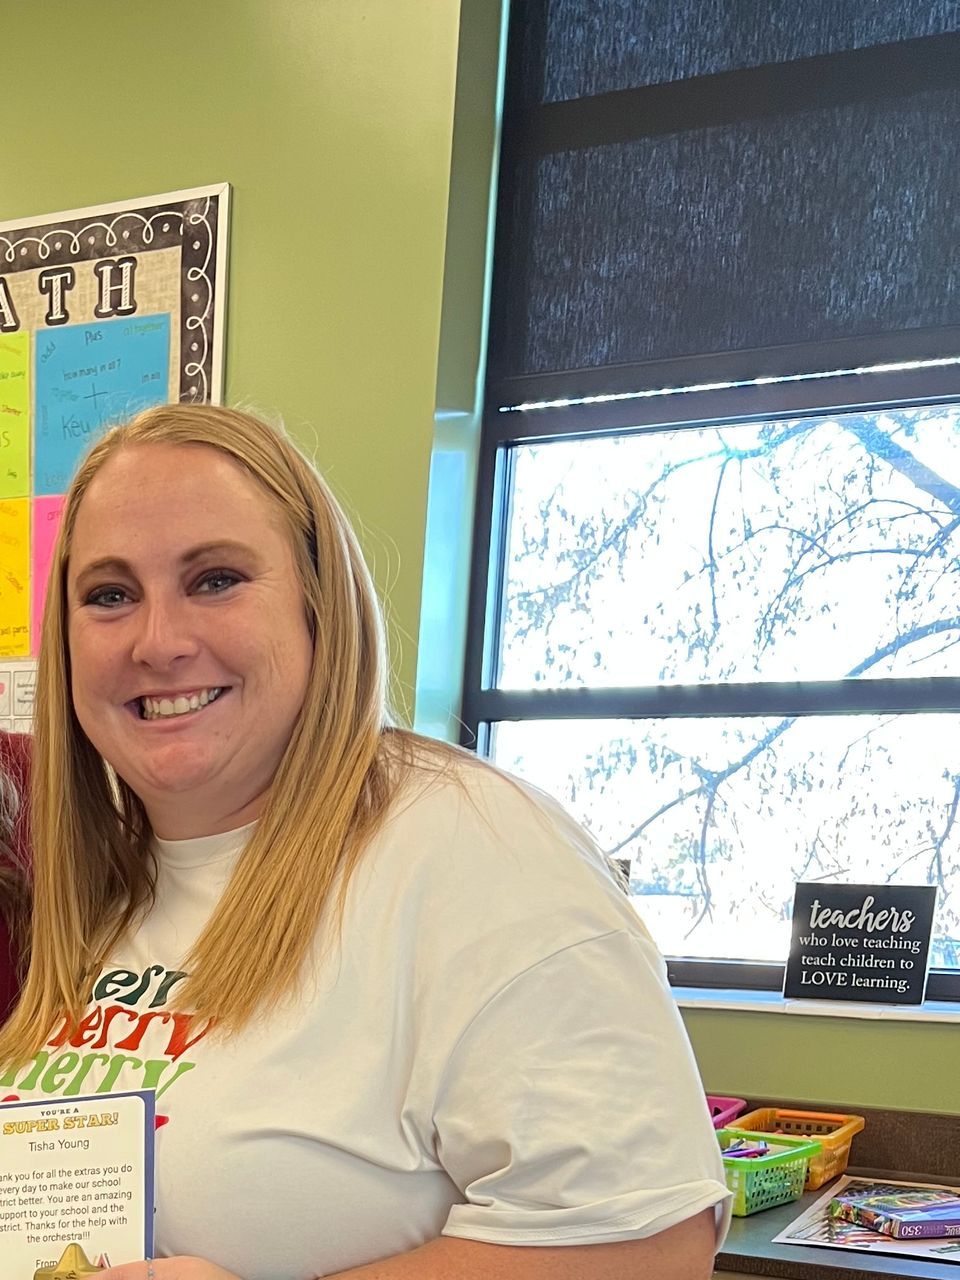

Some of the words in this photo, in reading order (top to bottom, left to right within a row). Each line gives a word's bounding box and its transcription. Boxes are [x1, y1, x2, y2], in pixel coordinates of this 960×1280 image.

[809, 896, 915, 933] teachers
[799, 933, 827, 947] who
[832, 933, 859, 948] love
[863, 936, 921, 953] teaching
[801, 953, 835, 966] teach
[840, 954, 895, 969] children
[900, 958, 914, 969] to
[92, 964, 189, 1008] err
[801, 971, 847, 986] LOVE
[851, 973, 910, 993] learning.
[40, 1108, 71, 1116] YOU'RE
[3, 1119, 60, 1135] SUPER
[63, 1112, 118, 1128] STAR!
[29, 1142, 55, 1152] Tisha
[58, 1139, 90, 1150] Young
[15, 1173, 30, 1182] you
[32, 1171, 44, 1179] for
[46, 1169, 56, 1178] all
[59, 1169, 72, 1177] the
[74, 1166, 100, 1176] extras
[103, 1166, 118, 1175] you
[121, 1164, 133, 1173] do
[22, 1184, 37, 1193] day
[39, 1183, 47, 1191] to
[50, 1181, 73, 1191] make
[76, 1180, 90, 1188] our
[92, 1178, 121, 1187] school
[18, 1196, 45, 1205] better.
[47, 1195, 63, 1203] You
[66, 1194, 79, 1202] are
[94, 1191, 132, 1203] amazing
[29, 1210, 38, 1218] to
[40, 1208, 58, 1218] your
[61, 1206, 89, 1215] school
[92, 1205, 108, 1214] and
[110, 1204, 124, 1212] the
[25, 1221, 56, 1230] Thanks
[58, 1219, 70, 1228] for
[72, 1218, 86, 1227] the
[88, 1217, 107, 1227] help
[109, 1216, 128, 1225] with
[27, 1234, 41, 1243] the
[43, 1232, 90, 1242] orchestra!!!
[901, 1225, 923, 1237] 350
[36, 1259, 57, 1268] From
